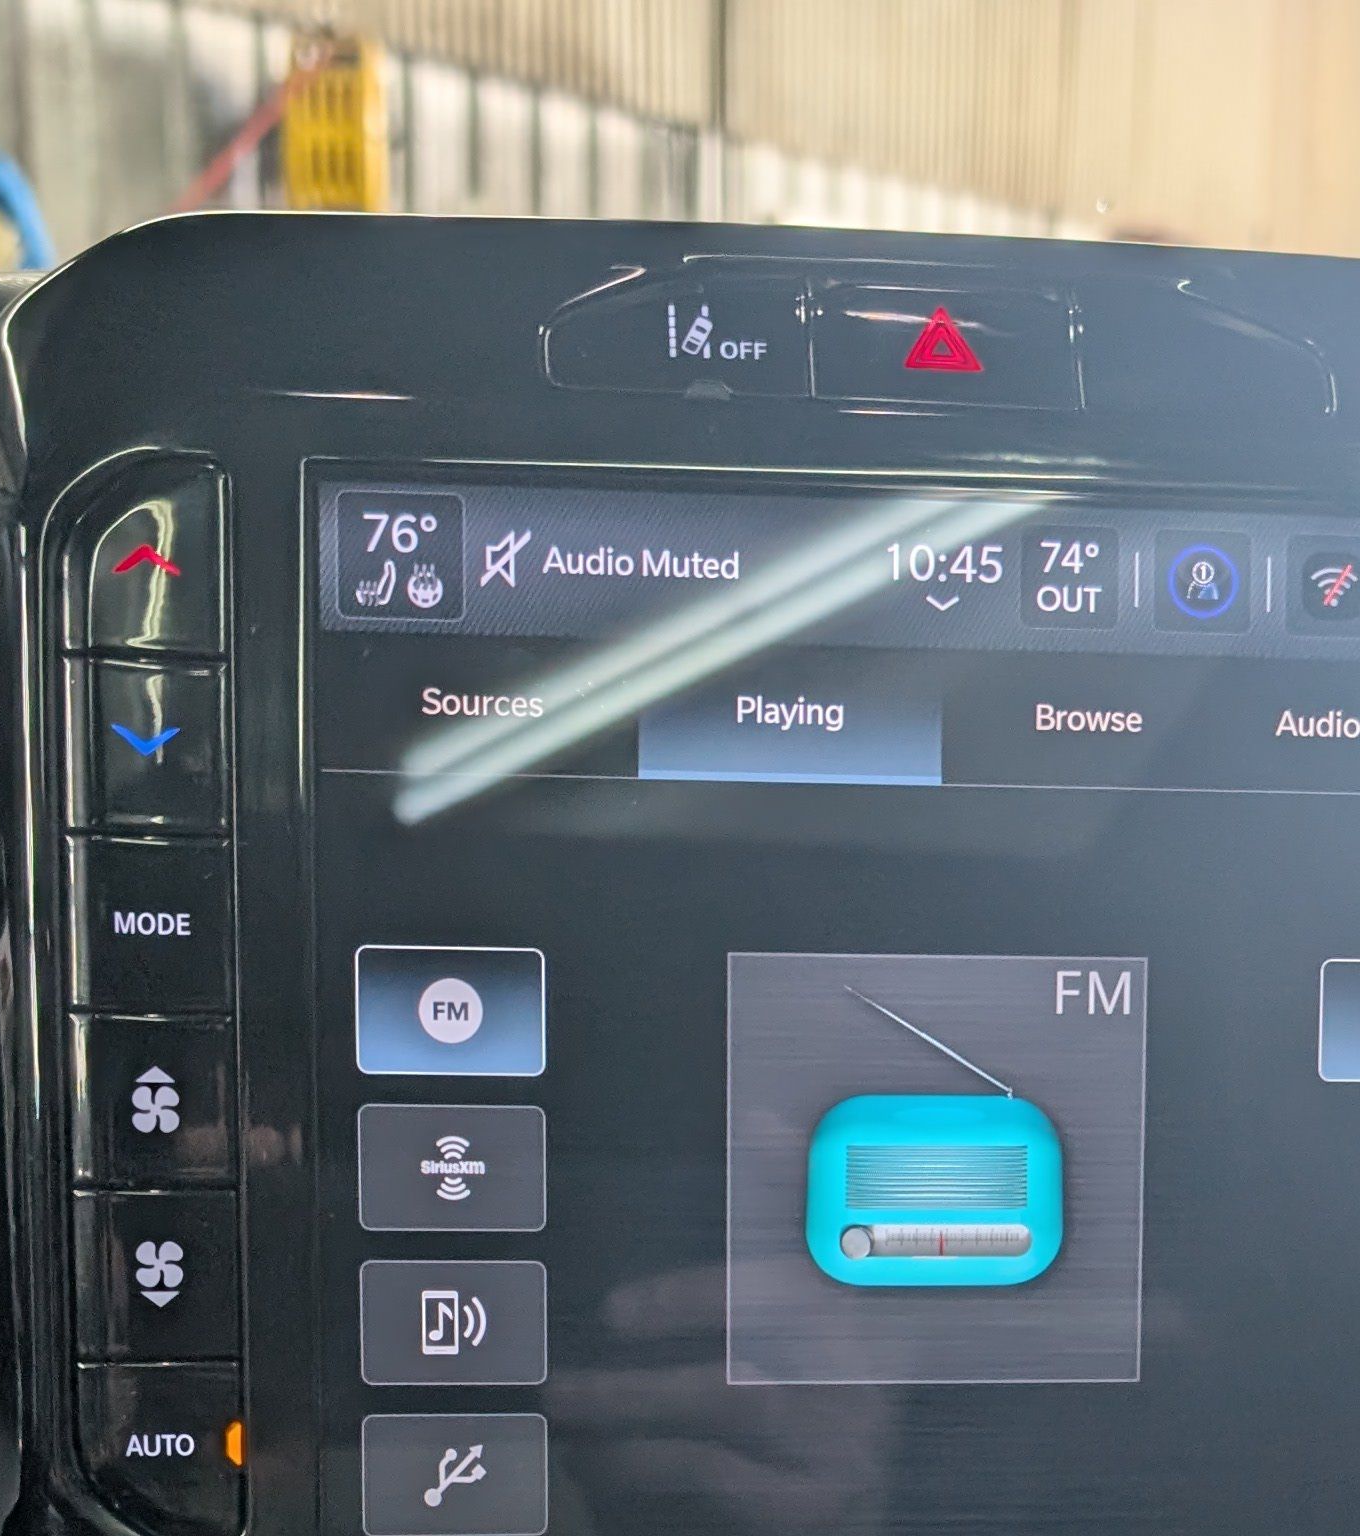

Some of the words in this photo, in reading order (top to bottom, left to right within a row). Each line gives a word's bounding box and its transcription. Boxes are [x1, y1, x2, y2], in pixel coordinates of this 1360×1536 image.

[720, 340, 767, 361] OFF
[362, 512, 438, 553] 76°
[542, 545, 634, 577] Audio
[641, 550, 740, 580] Muted
[885, 542, 1003, 585] 10:45
[1040, 541, 1100, 574] 74°
[1036, 587, 1103, 614] OUT
[421, 687, 544, 719] Sources
[736, 696, 845, 731] Playing
[1035, 705, 1143, 735] Browse
[1275, 709, 1360, 740] Audio
[114, 912, 191, 936] MODE
[1055, 971, 1133, 1015] FM
[431, 1001, 469, 1021] FM
[126, 1434, 195, 1458] AUTO
